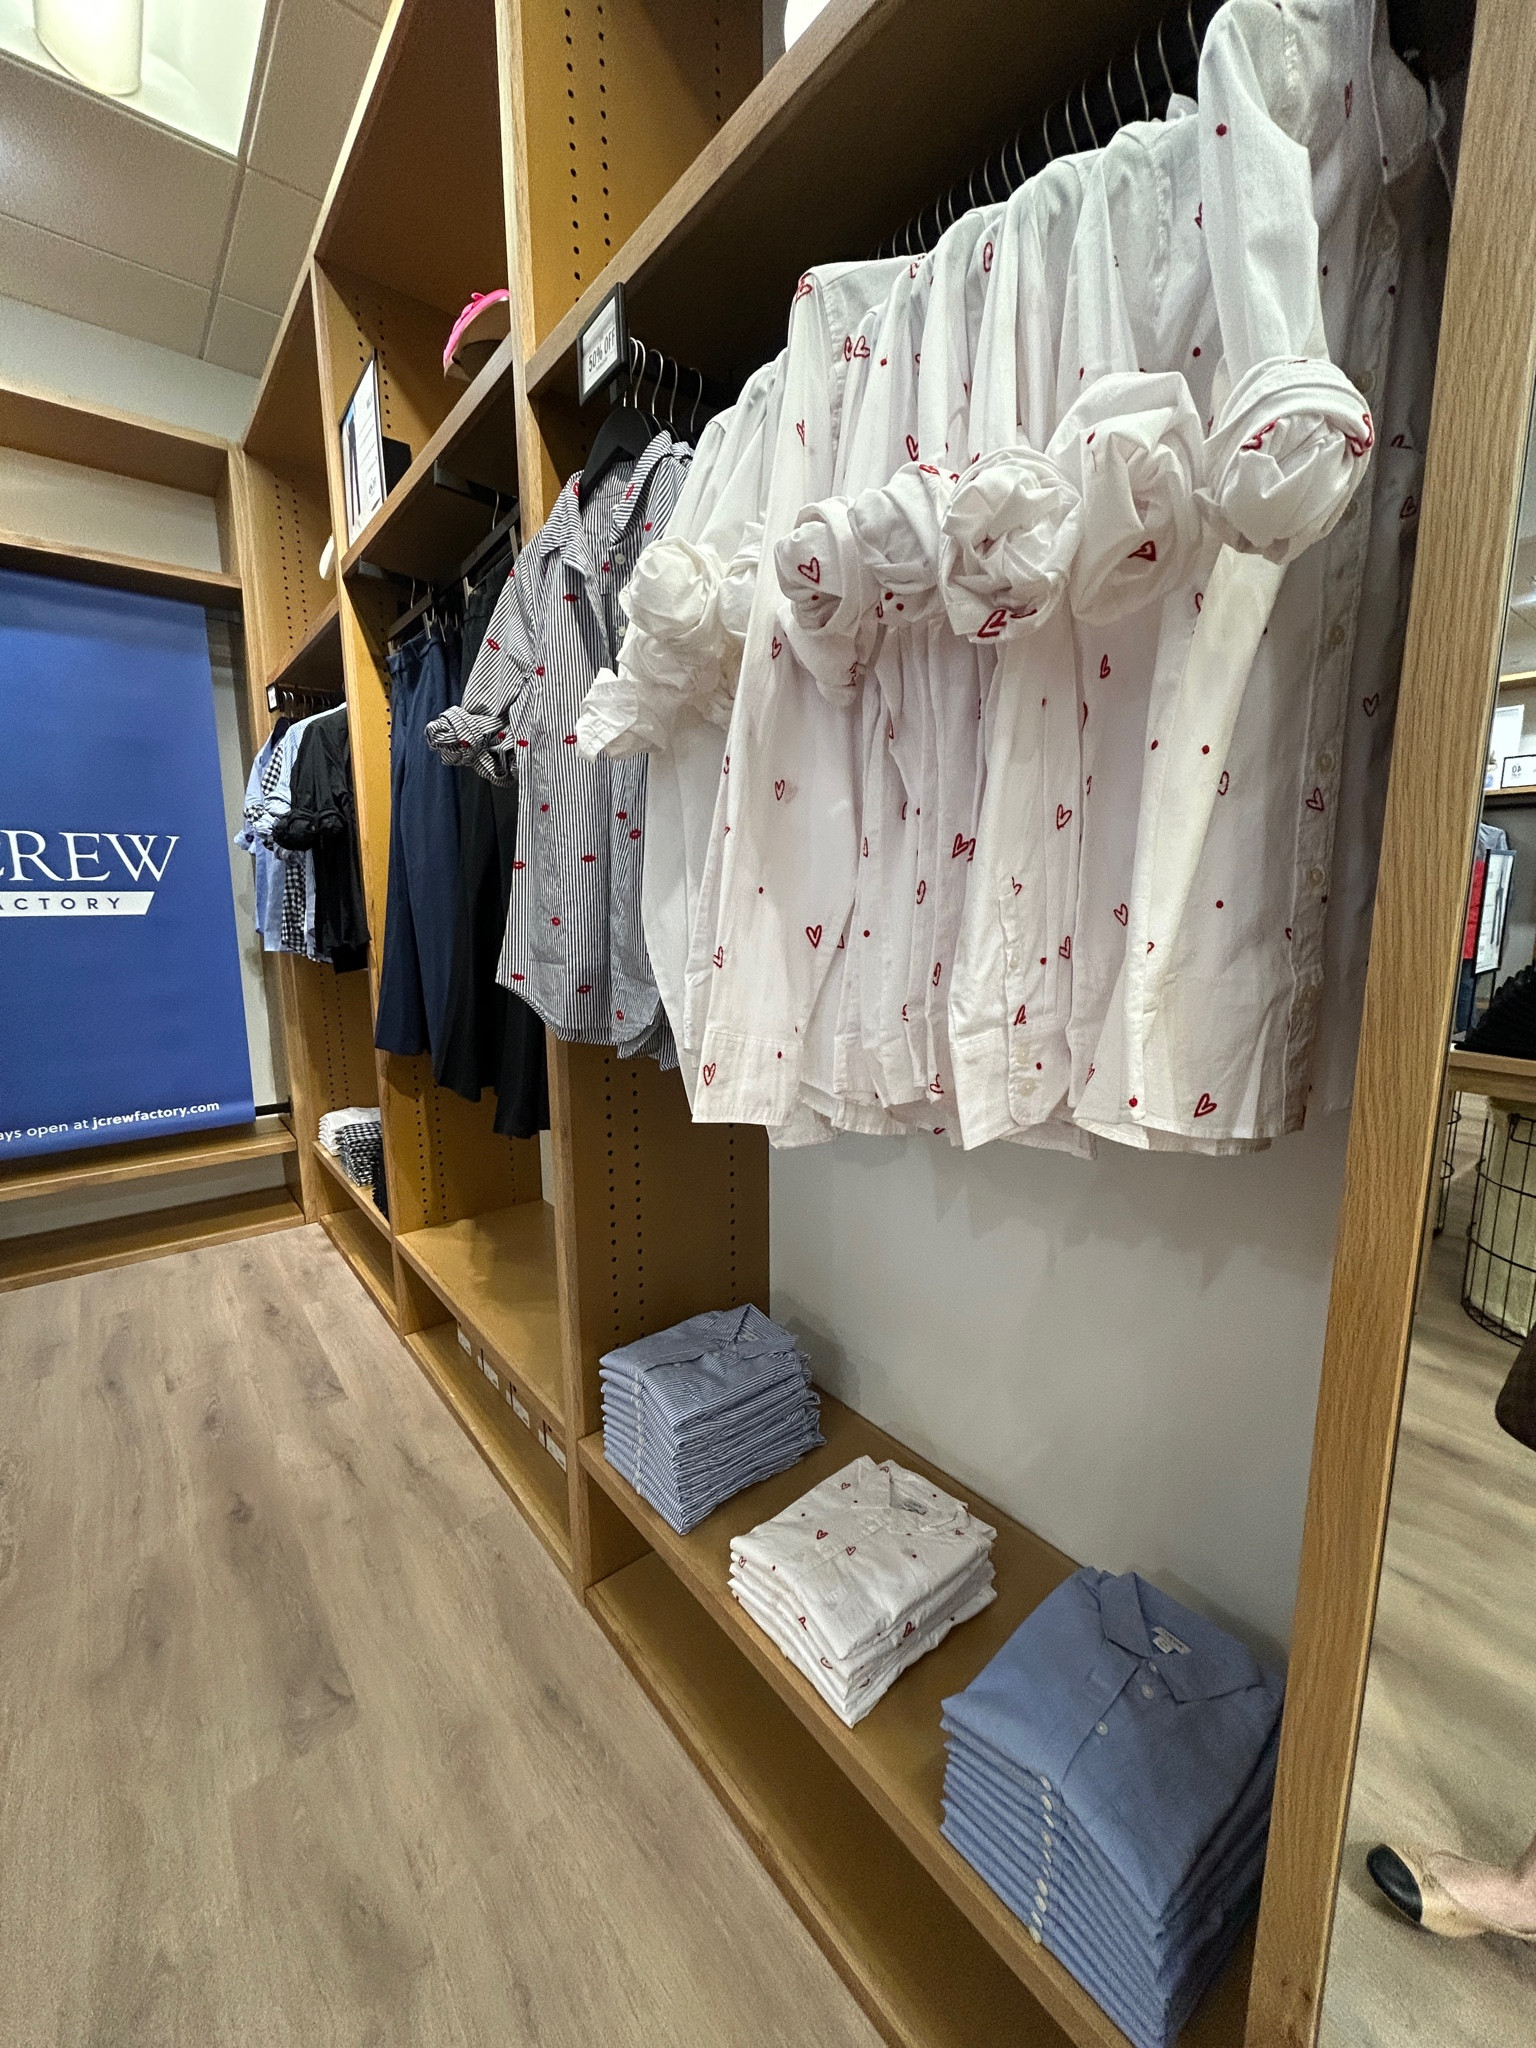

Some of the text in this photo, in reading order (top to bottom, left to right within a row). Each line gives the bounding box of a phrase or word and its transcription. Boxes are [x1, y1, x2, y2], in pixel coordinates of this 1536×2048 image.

[589, 345, 603, 372] 50%
[604, 327, 616, 354] OFF
[0, 829, 180, 882] REW
[0, 897, 120, 911] CTORY
[27, 1123, 69, 1138] open
[74, 1119, 89, 1130] at
[92, 1101, 220, 1131] jcrewfactory.com
